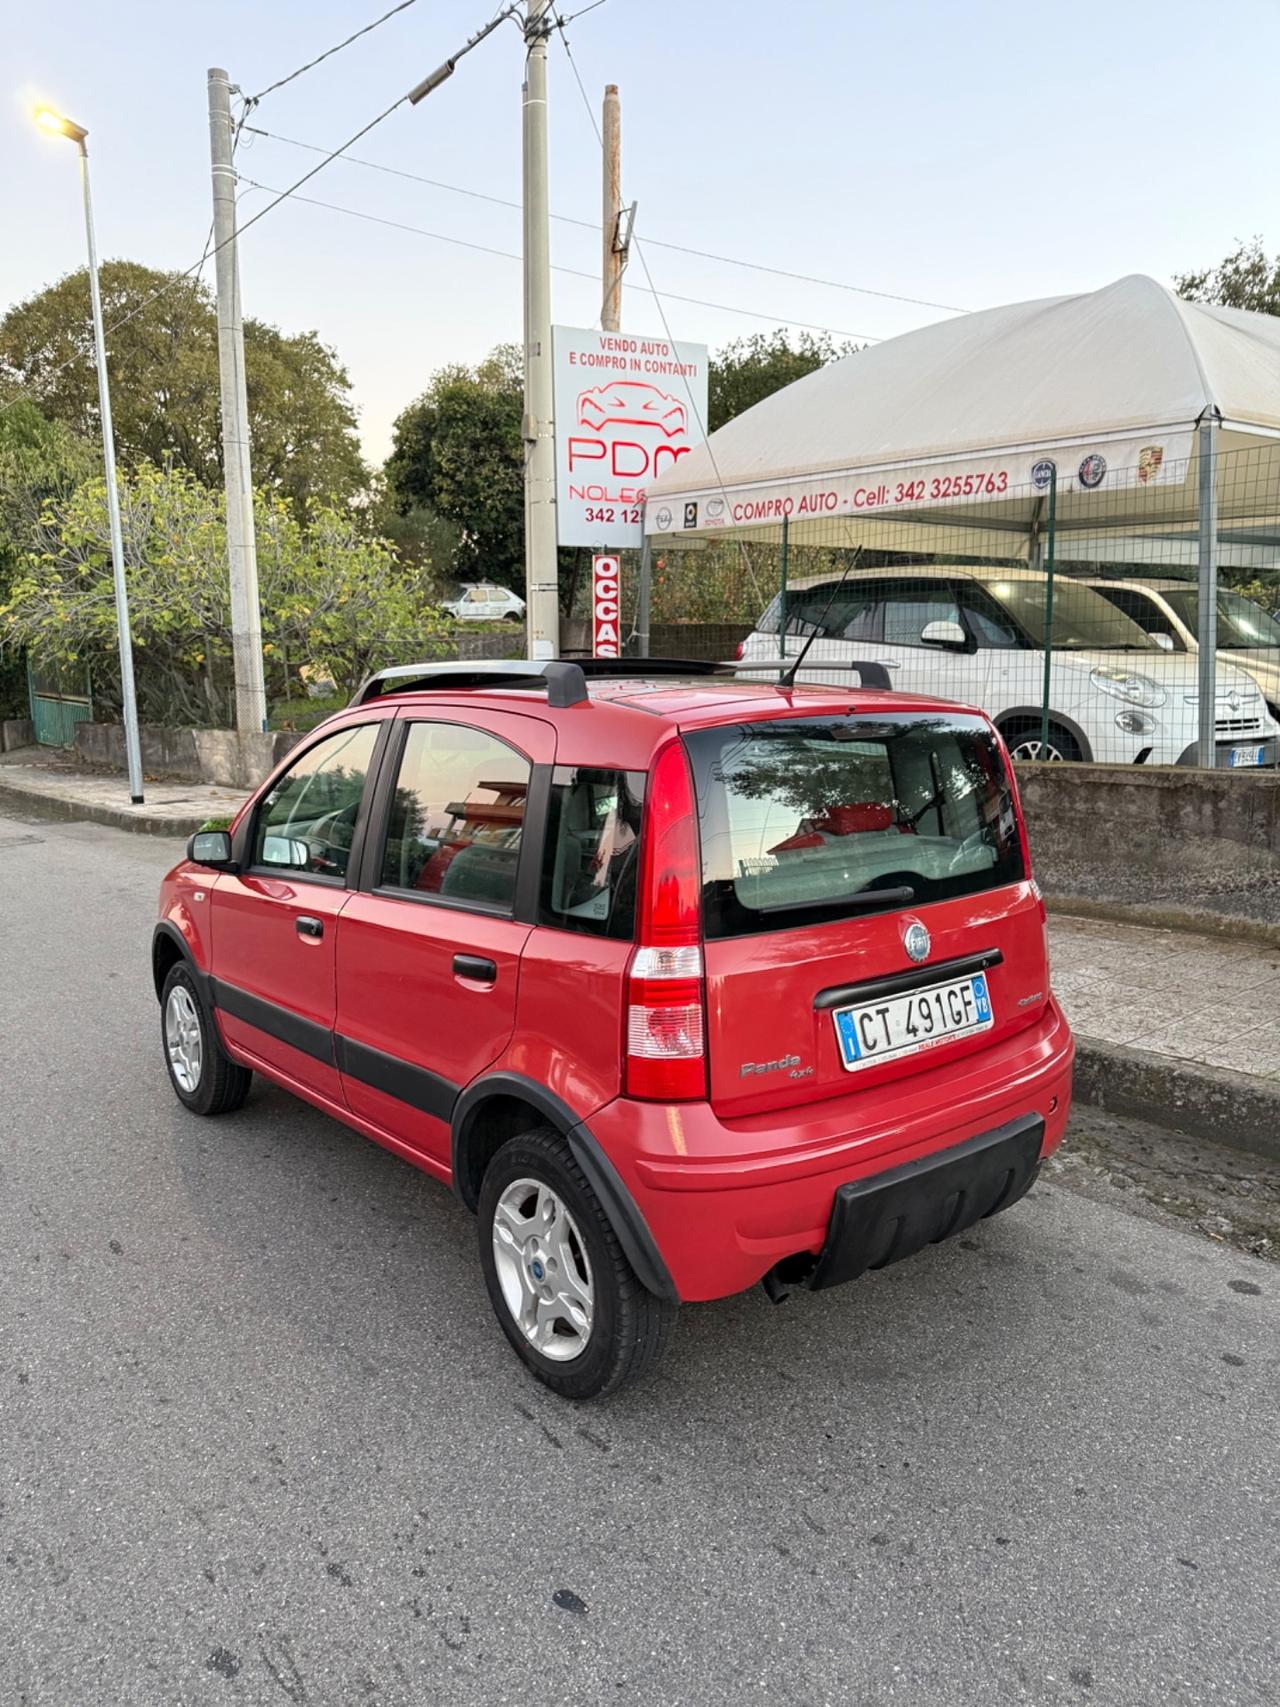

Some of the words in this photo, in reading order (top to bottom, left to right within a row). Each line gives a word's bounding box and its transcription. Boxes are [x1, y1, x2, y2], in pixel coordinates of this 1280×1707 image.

[600, 337, 637, 353] VENDO
[640, 342, 669, 357] AUTO
[569, 352, 576, 364] E
[580, 353, 627, 370] COMPRO
[630, 358, 641, 371] IN
[645, 360, 697, 377] CONTANTI
[733, 497, 794, 521] COMPRO
[798, 491, 838, 514] AUTO
[853, 485, 890, 507] Cell:
[894, 479, 926, 503] 342
[930, 471, 1008, 499] 3255763
[585, 508, 615, 522] 342
[621, 509, 644, 523] 12
[859, 1007, 892, 1051] CT
[906, 985, 973, 1037] 491GF
[740, 1054, 801, 1079] Panda
